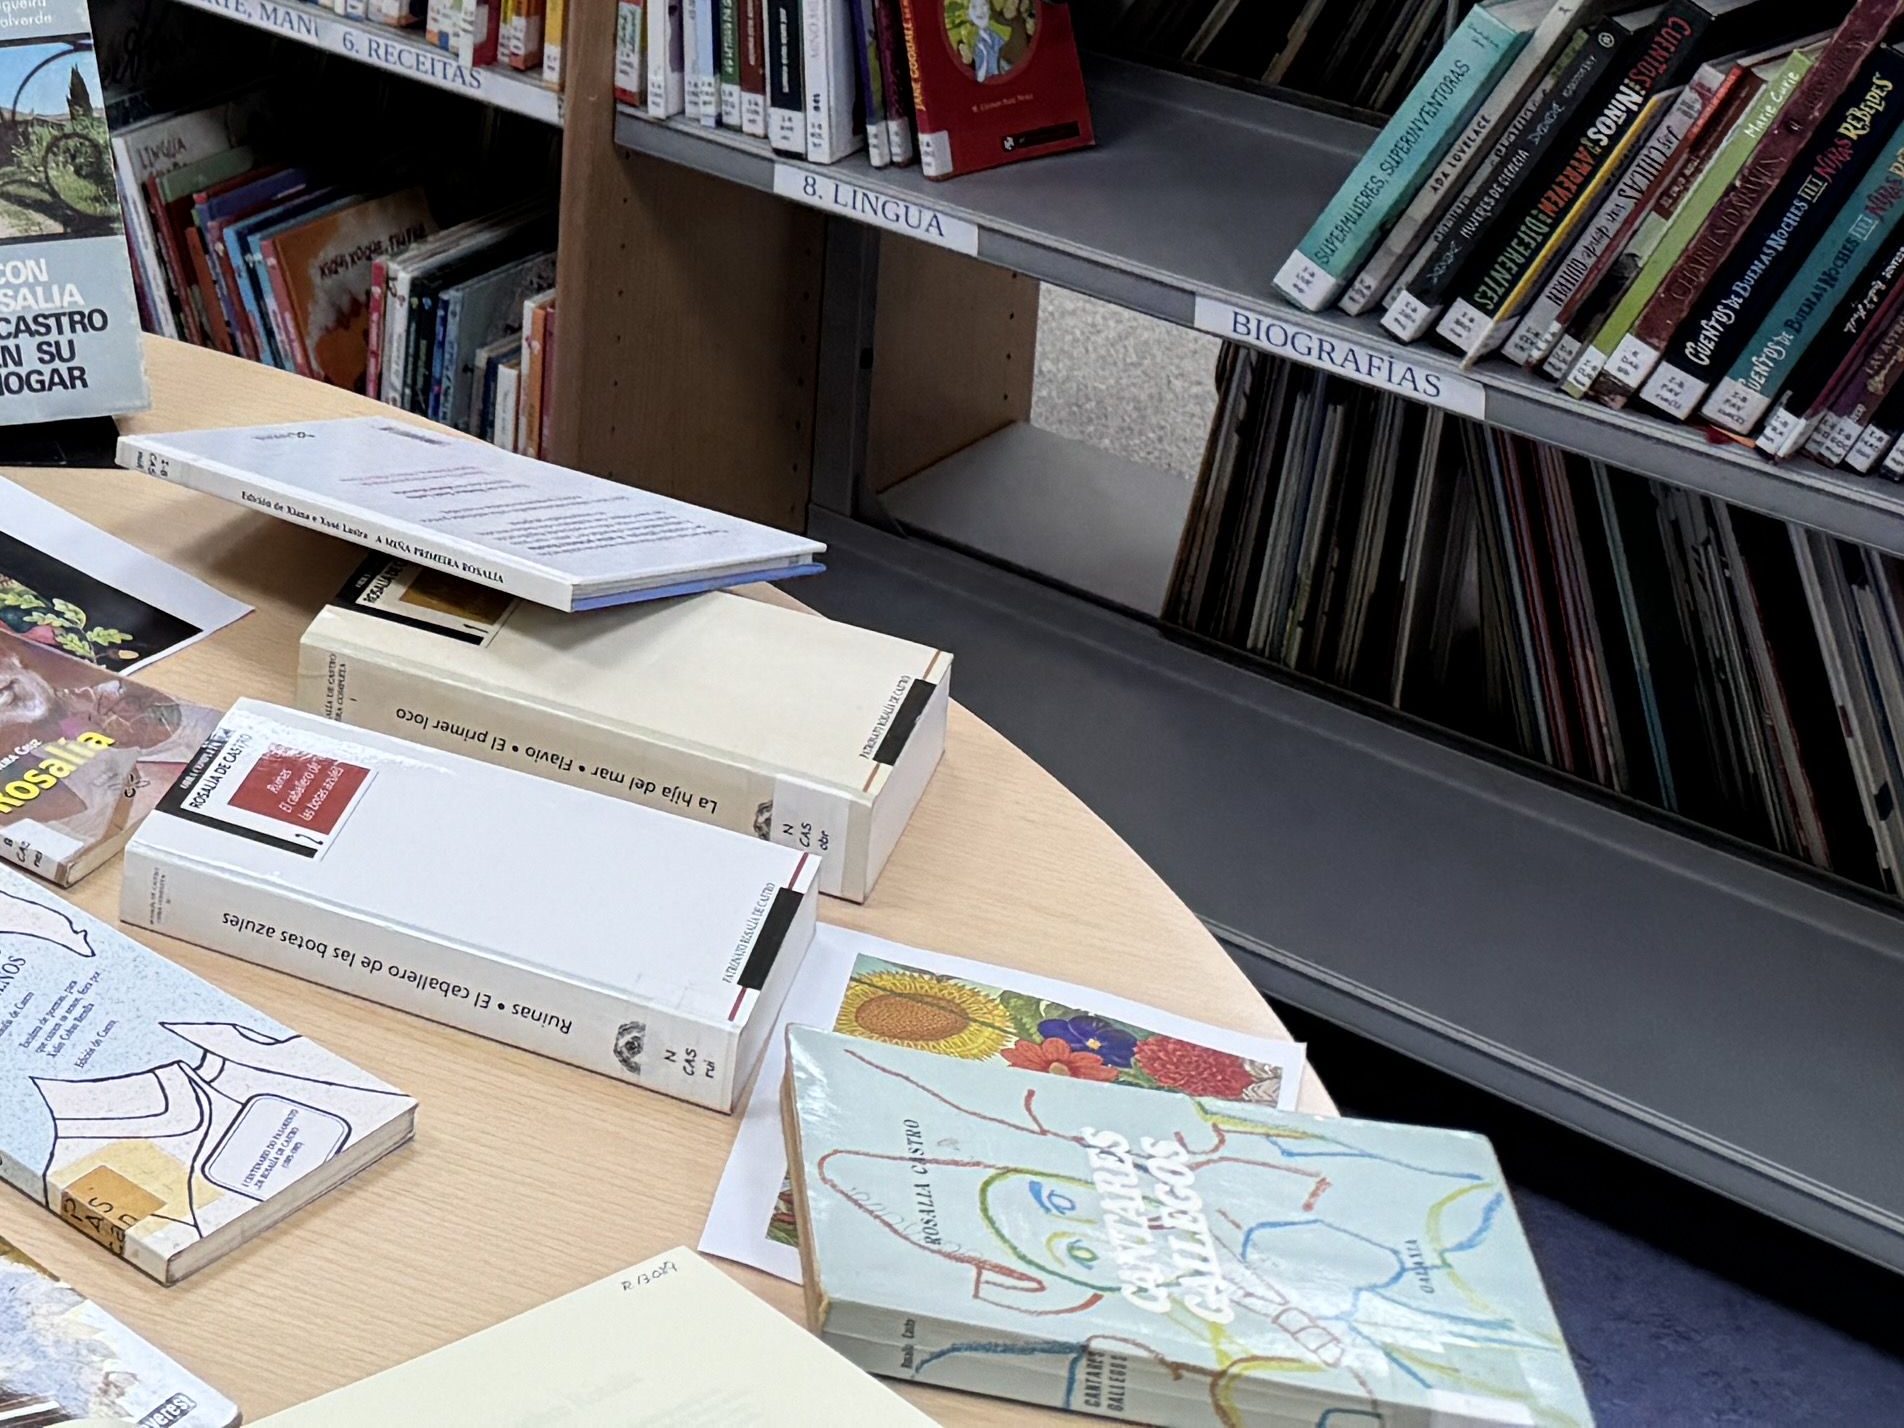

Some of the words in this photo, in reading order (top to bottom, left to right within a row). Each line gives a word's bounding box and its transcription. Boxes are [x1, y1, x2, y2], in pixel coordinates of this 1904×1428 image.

[343, 32, 358, 51] 6.
[363, 38, 481, 90] RECEITAS
[1744, 100, 1773, 140] Marie
[1769, 73, 1799, 107] Curie
[803, 176, 823, 198] 8.
[833, 184, 945, 237] LINGUA
[36, 341, 77, 365] SU
[1231, 309, 1442, 399] BIOGRAFÍAS
[396, 707, 429, 730] loco
[432, 718, 489, 744] primer
[491, 737, 506, 752] El
[525, 745, 572, 772] Flavio
[591, 767, 625, 785] mar
[629, 776, 657, 794] del
[662, 785, 692, 807] hija
[699, 798, 718, 814] La
[222, 911, 276, 938] azules
[280, 930, 328, 959] botas
[333, 946, 357, 967] las
[361, 957, 383, 974] de
[388, 965, 470, 1000] caballero
[474, 992, 492, 1009] El
[512, 1003, 573, 1035] Ruinas
[904, 1119, 929, 1174] CASTRO
[913, 1183, 941, 1246] ROSALIA
